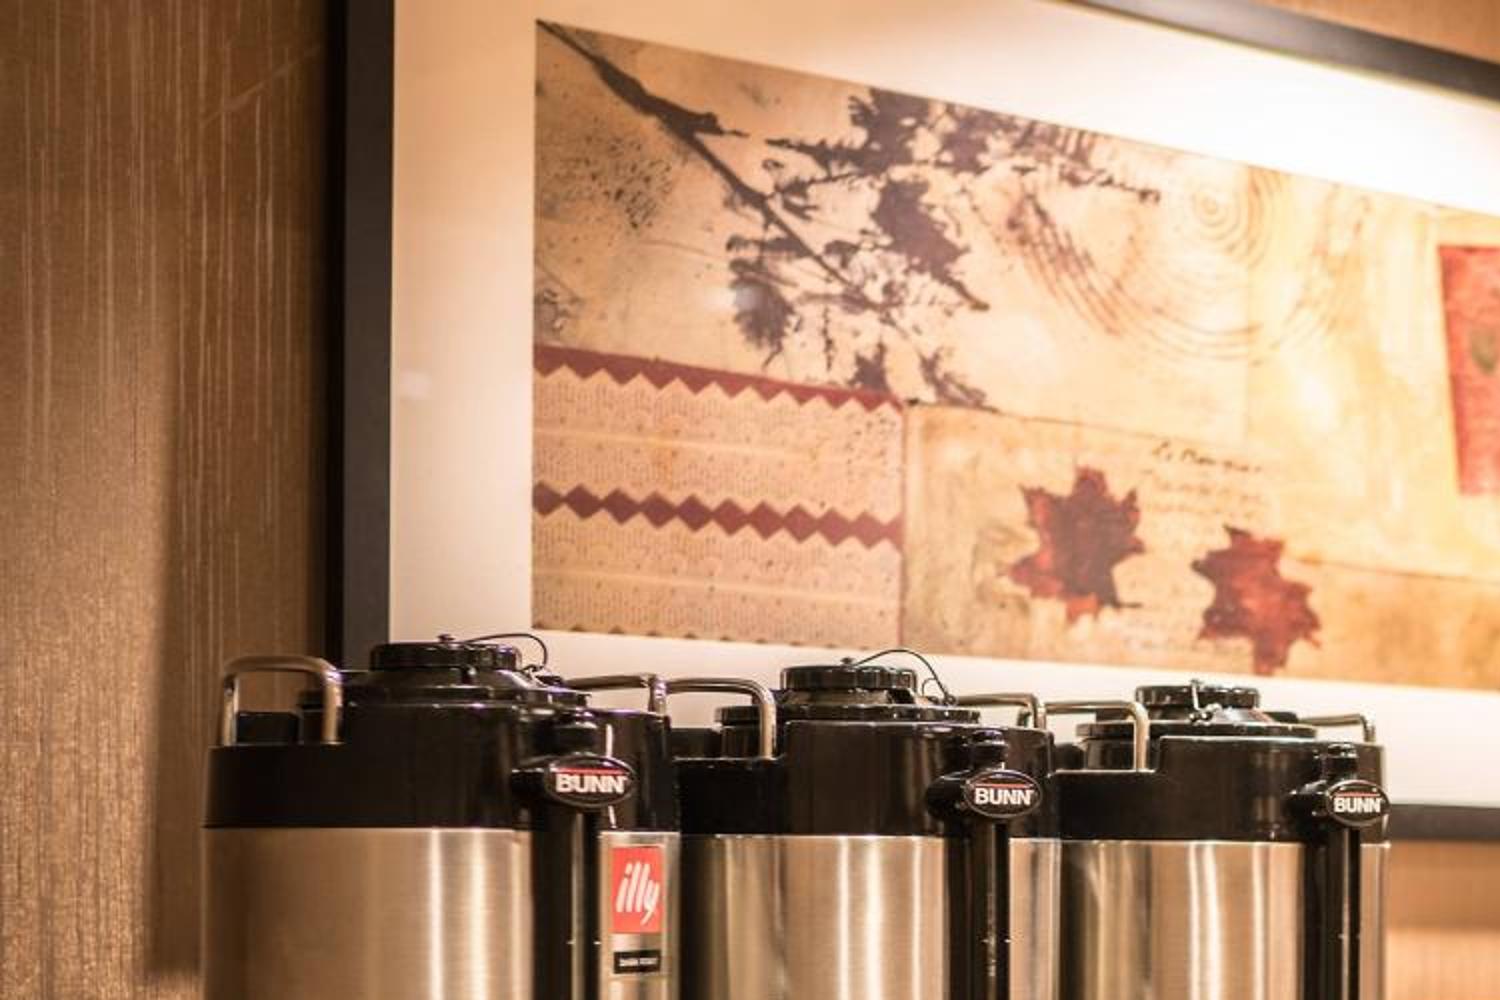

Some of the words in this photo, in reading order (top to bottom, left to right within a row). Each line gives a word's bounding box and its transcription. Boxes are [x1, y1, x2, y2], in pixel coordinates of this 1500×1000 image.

[556, 774, 625, 794] BUNN
[975, 788, 1032, 806] BUNN
[1334, 797, 1381, 813] BUNN
[616, 861, 660, 926] illy
